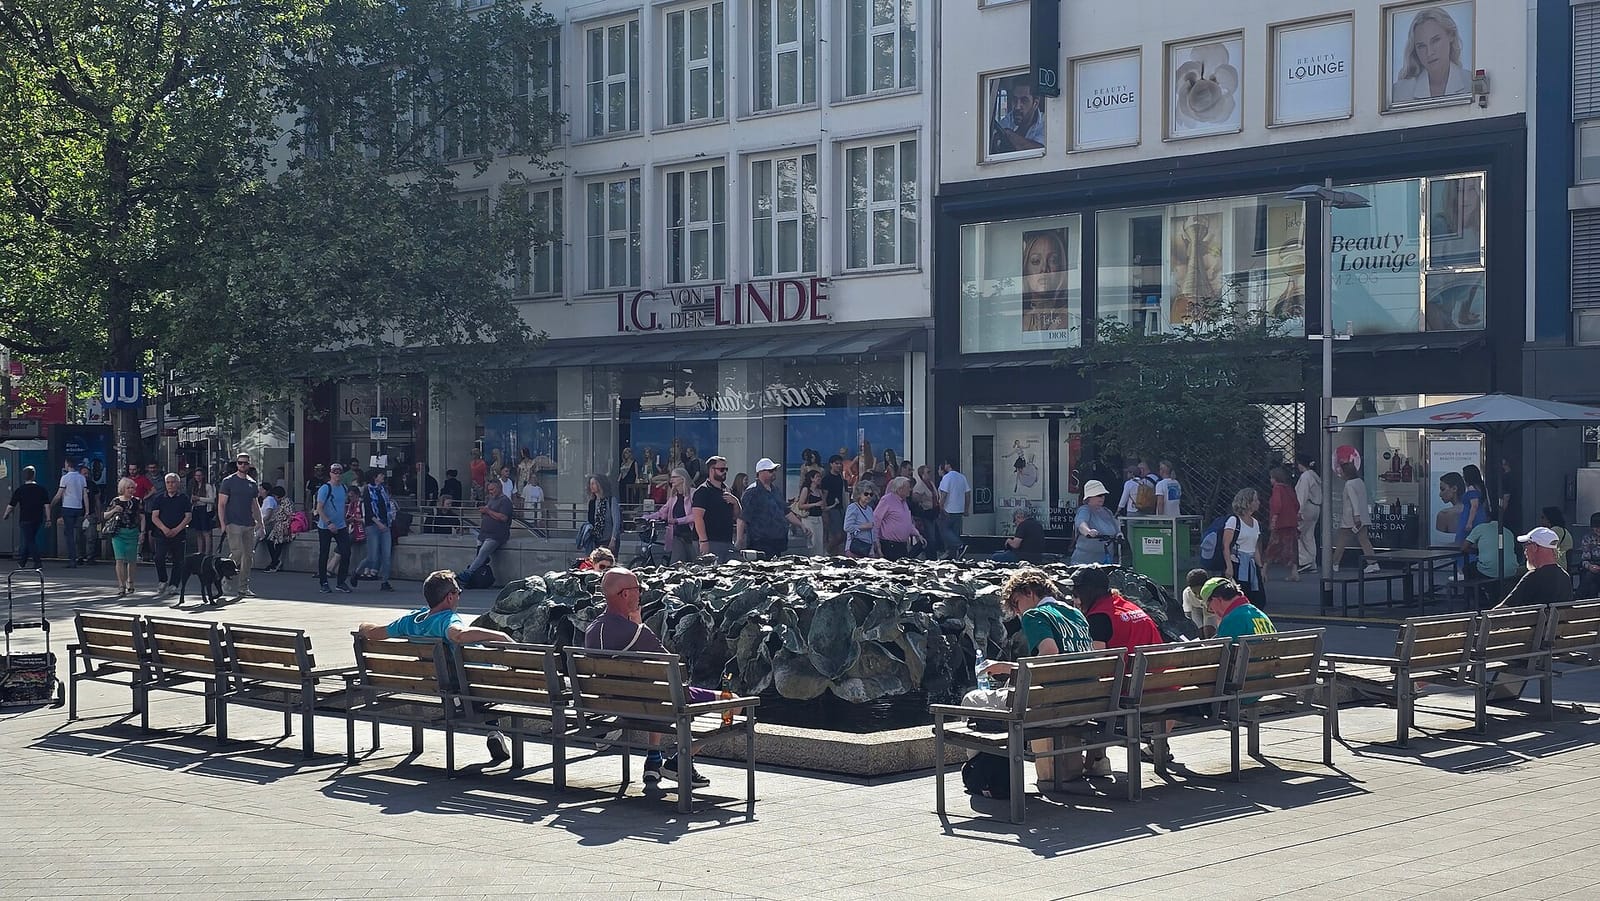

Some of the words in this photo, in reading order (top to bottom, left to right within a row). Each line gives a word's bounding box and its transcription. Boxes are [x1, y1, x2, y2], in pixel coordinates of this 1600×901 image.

[1297, 53, 1336, 65] BEAUTY
[1288, 60, 1345, 80] LOUNGE
[1094, 84, 1128, 96] BEAUTY
[1086, 92, 1135, 110] LOUNGE
[1331, 232, 1404, 253] Beauty
[1340, 253, 1416, 273] Lounge
[670, 289, 705, 306] VON
[714, 277, 830, 326] LINDE
[617, 290, 665, 332] I.G.
[670, 310, 705, 329] DER
[1049, 331, 1067, 340] DIOR
[103, 377, 115, 403] U
[119, 377, 139, 403] U
[1385, 513, 1406, 521] LOVE
